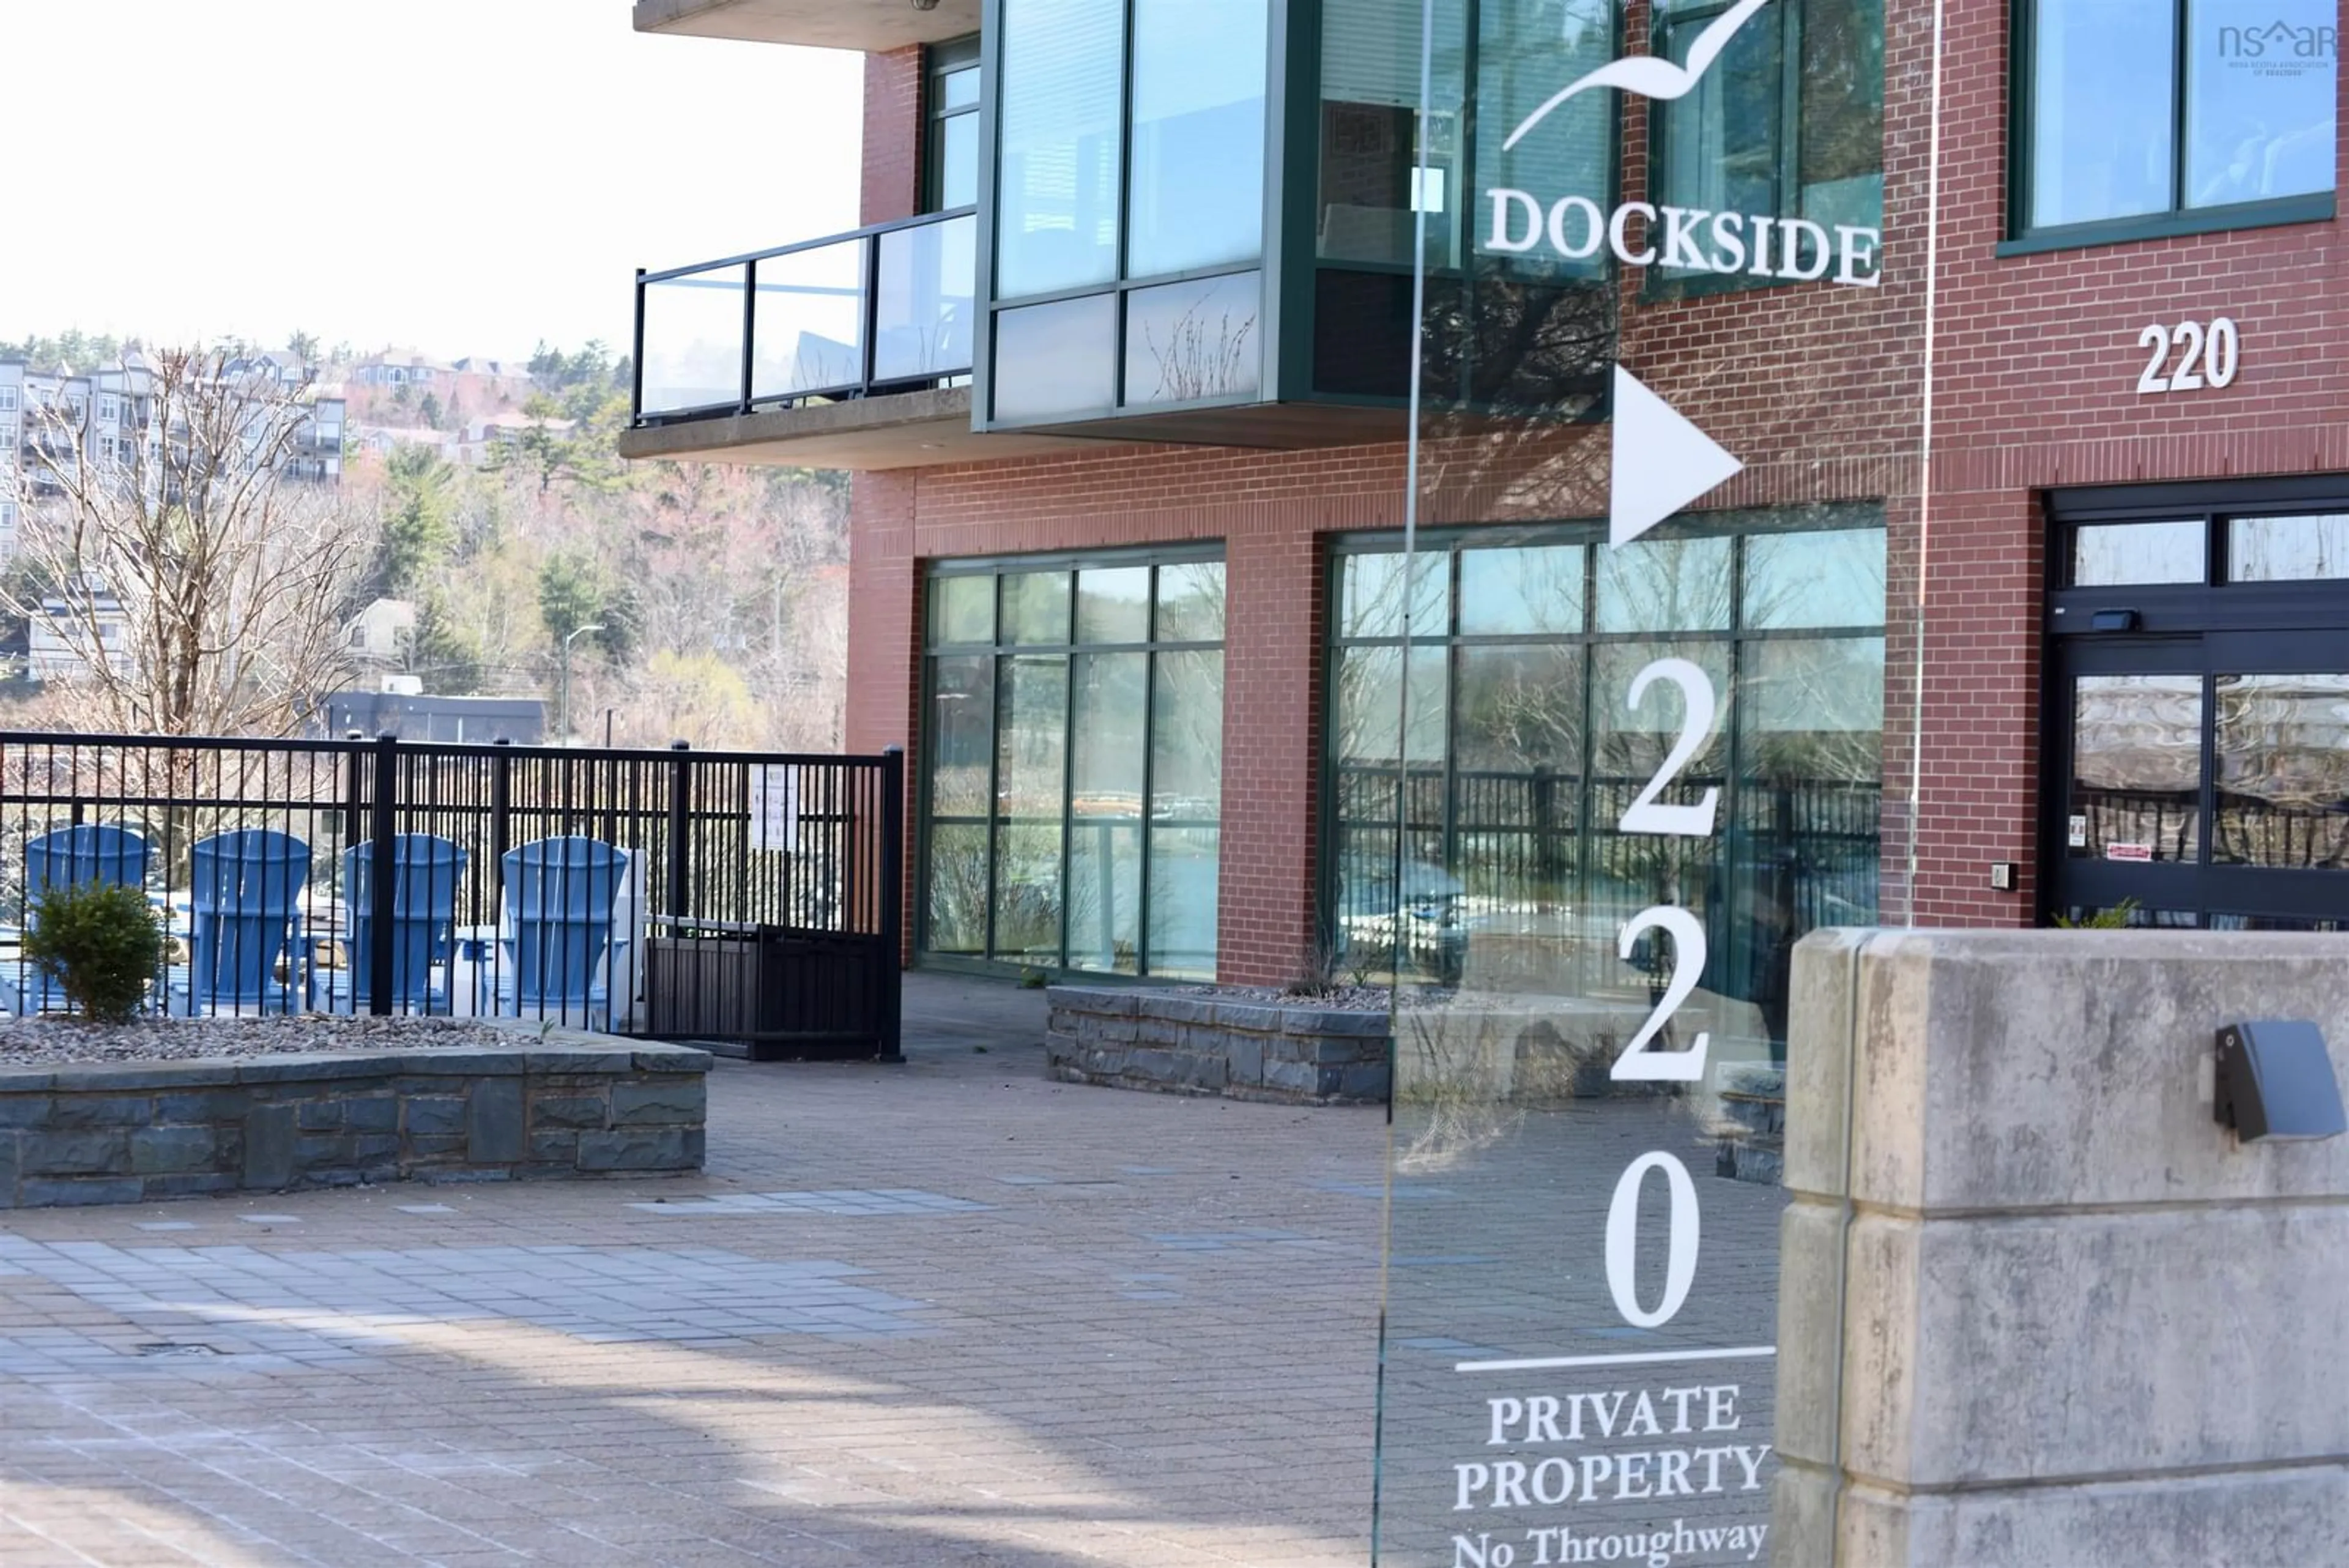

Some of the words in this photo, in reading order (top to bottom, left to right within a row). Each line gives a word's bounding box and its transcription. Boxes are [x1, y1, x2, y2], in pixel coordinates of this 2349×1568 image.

[1485, 188, 1881, 288] DOCKSIDE
[2137, 317, 2239, 393] 220
[1486, 1384, 1742, 1445] PRIVATE
[1452, 1444, 1773, 1510] PROPERTY
[1452, 1533, 1515, 1568] No
[1526, 1518, 1769, 1568] Throughway
